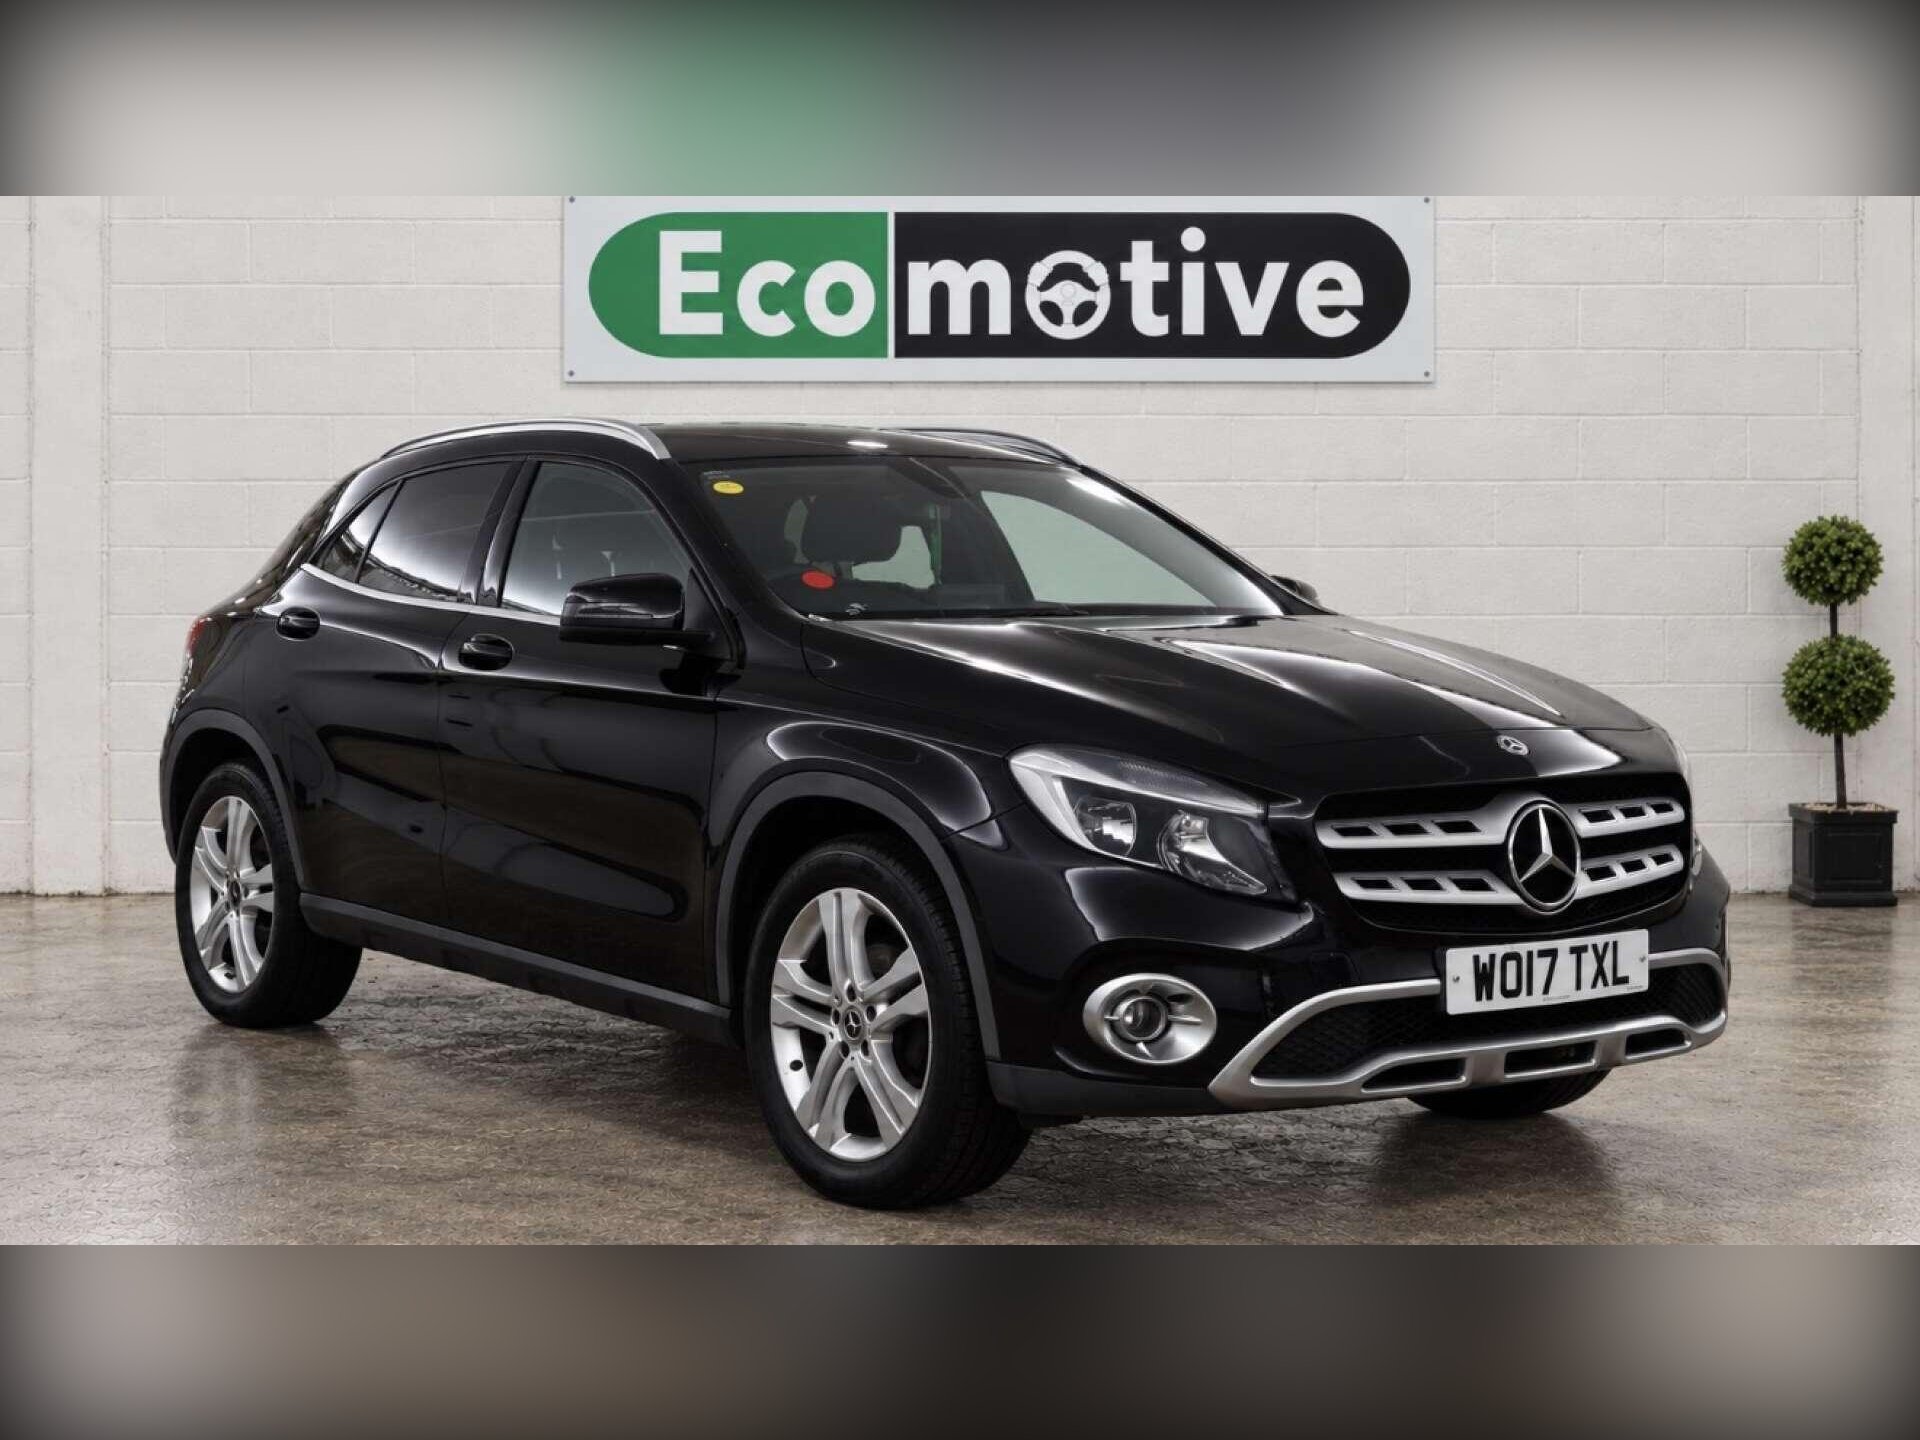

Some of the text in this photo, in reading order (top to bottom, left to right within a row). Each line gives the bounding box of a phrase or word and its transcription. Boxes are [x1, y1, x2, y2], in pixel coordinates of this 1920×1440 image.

[659, 226, 1363, 339] Ecomotive
[1473, 941, 1629, 1001] WO17 TXL
